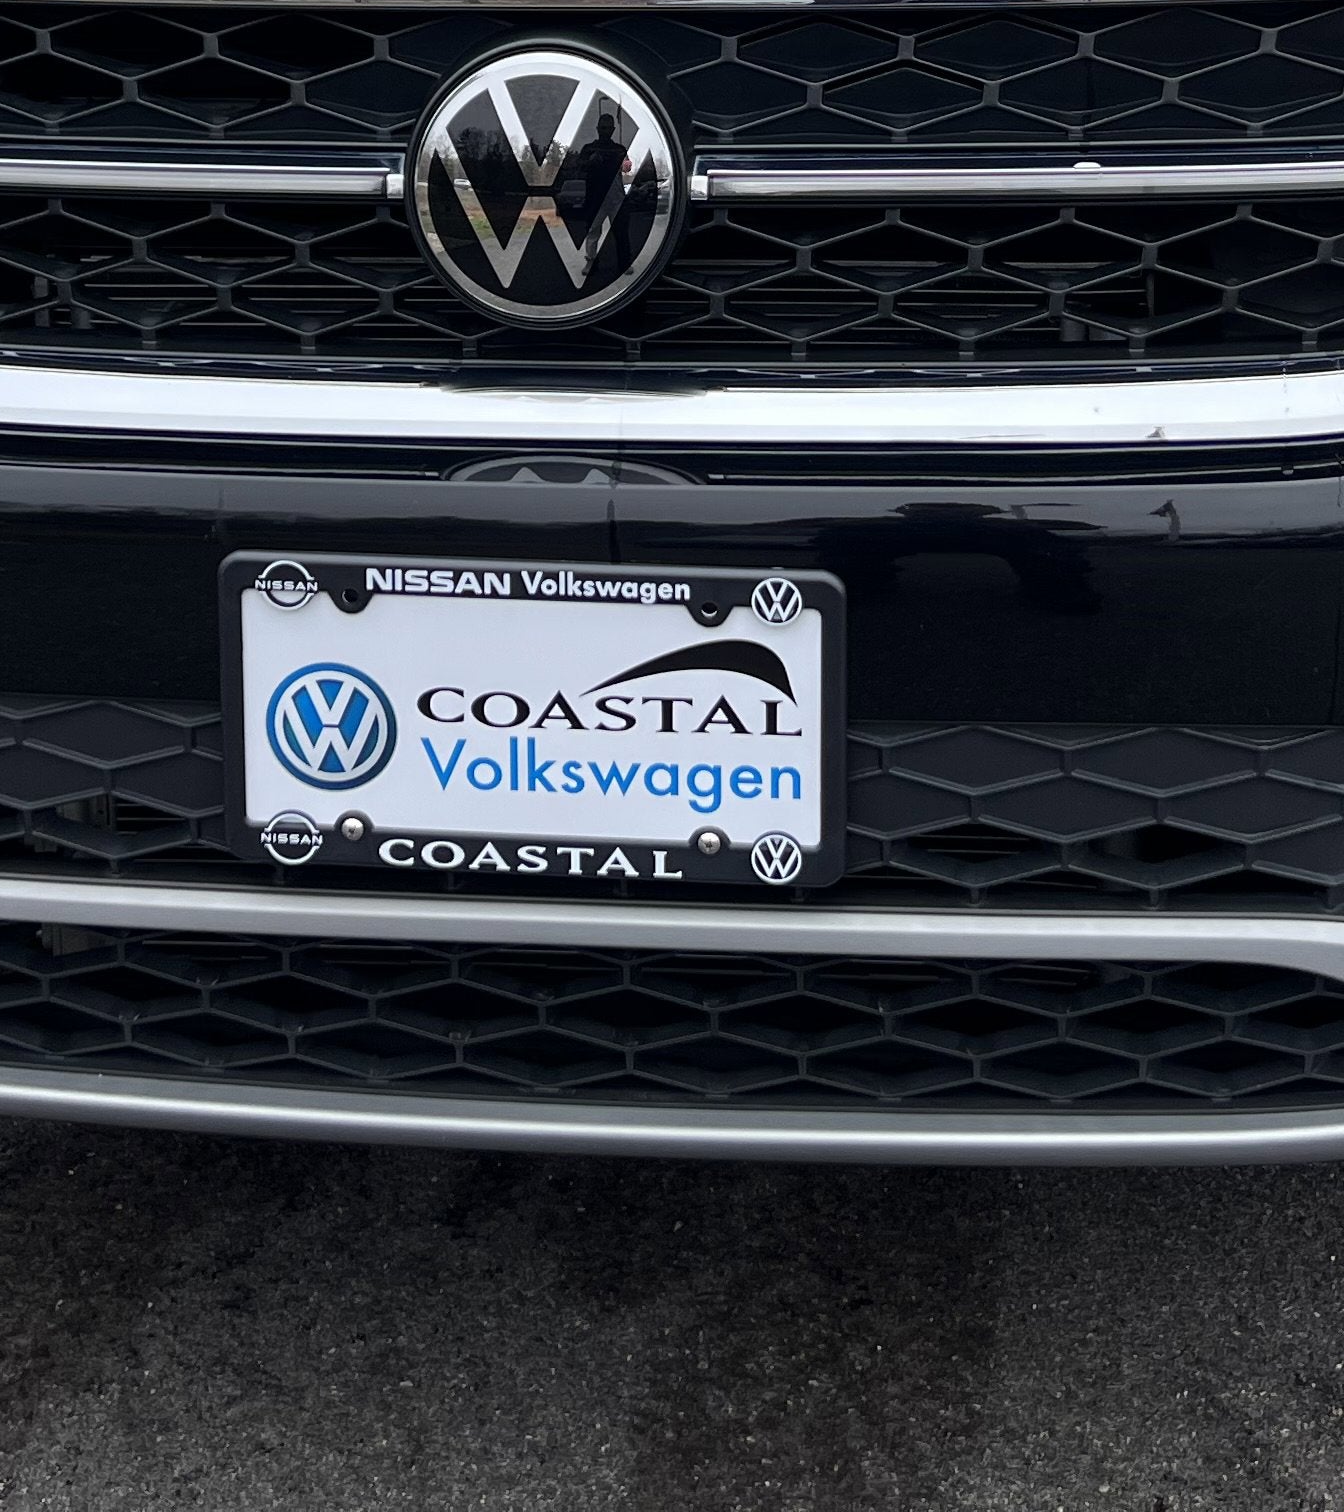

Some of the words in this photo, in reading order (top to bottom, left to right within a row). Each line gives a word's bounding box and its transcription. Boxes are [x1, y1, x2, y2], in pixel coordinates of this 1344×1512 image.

[422, 60, 664, 306] VW
[255, 579, 318, 592] NISSAN
[365, 567, 512, 596] NISSAN
[520, 570, 691, 604] Volkswagen
[754, 580, 800, 624] VW
[273, 669, 391, 784] VW
[416, 686, 803, 737] COASTAL
[420, 736, 803, 814] Volkswagen
[260, 832, 323, 846] NISSAN
[377, 838, 684, 880] COASTAL
[754, 835, 800, 882] VW
